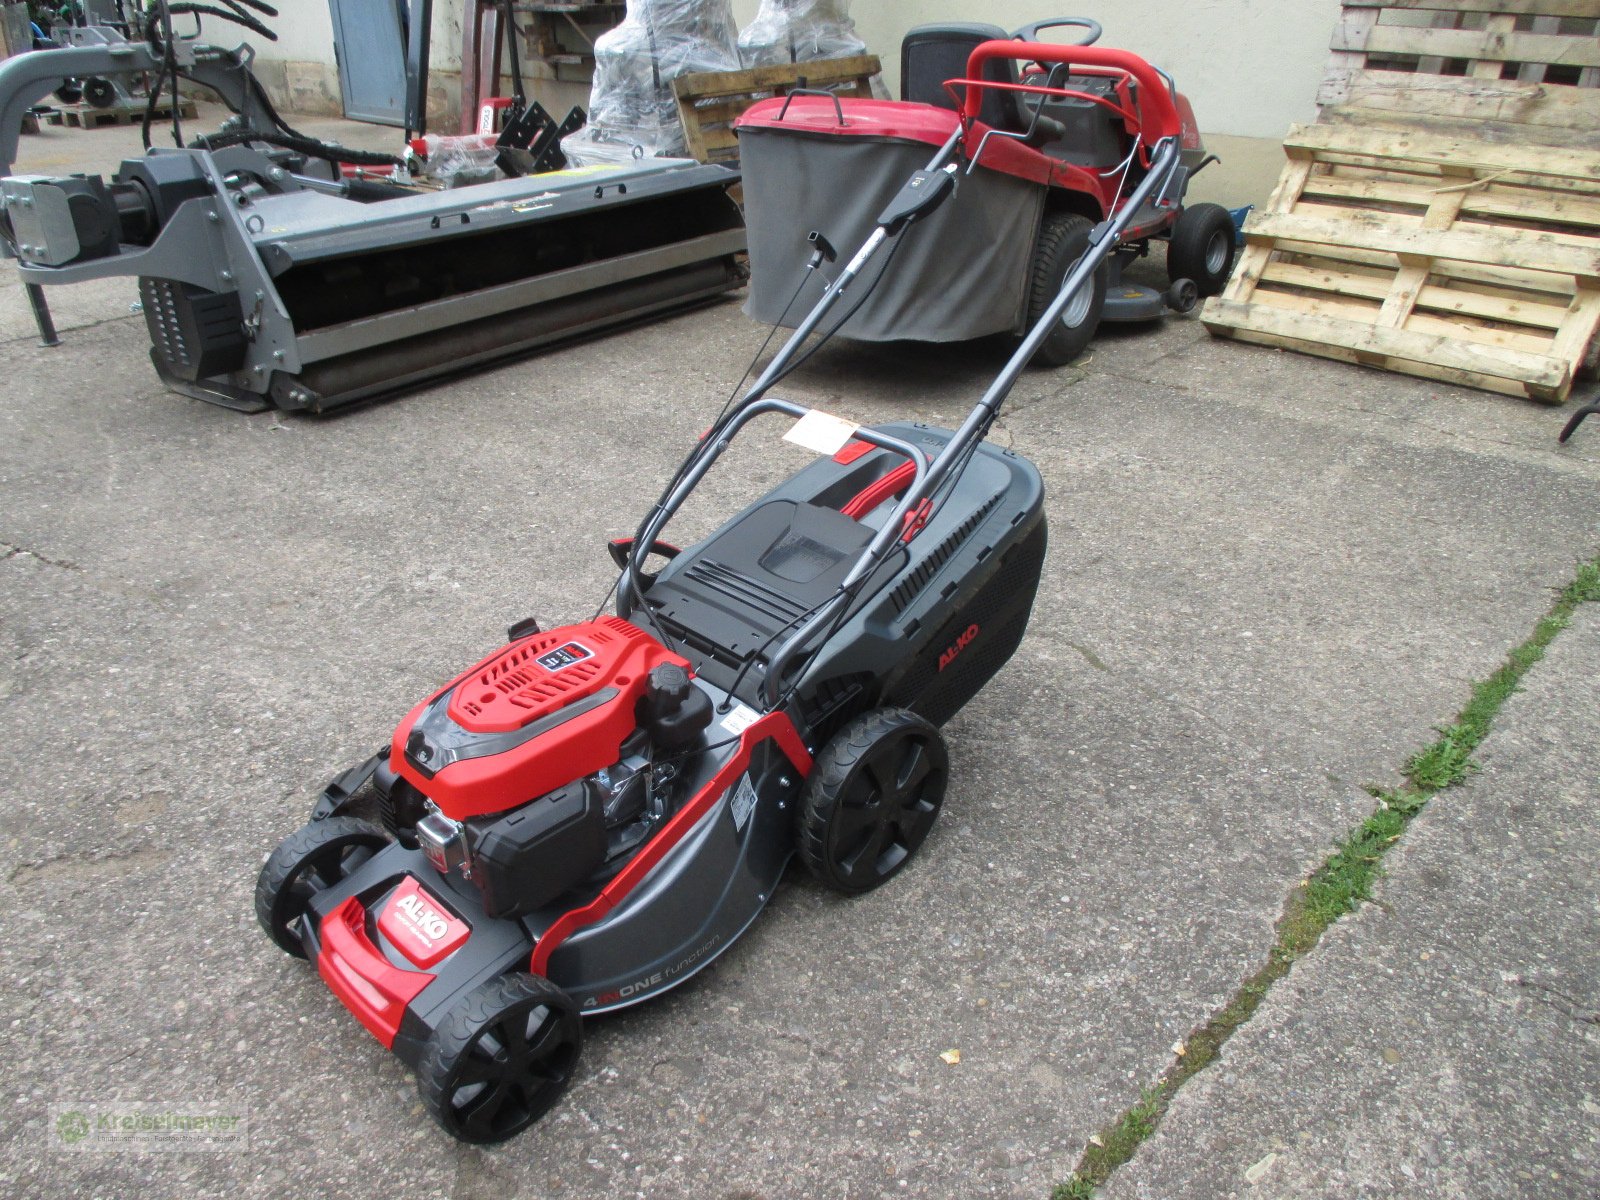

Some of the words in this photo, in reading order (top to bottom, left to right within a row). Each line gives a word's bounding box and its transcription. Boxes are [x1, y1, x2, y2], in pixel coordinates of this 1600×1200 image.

[938, 623, 979, 673] AL-KO
[396, 894, 448, 940] AL-KO
[665, 933, 721, 977] function
